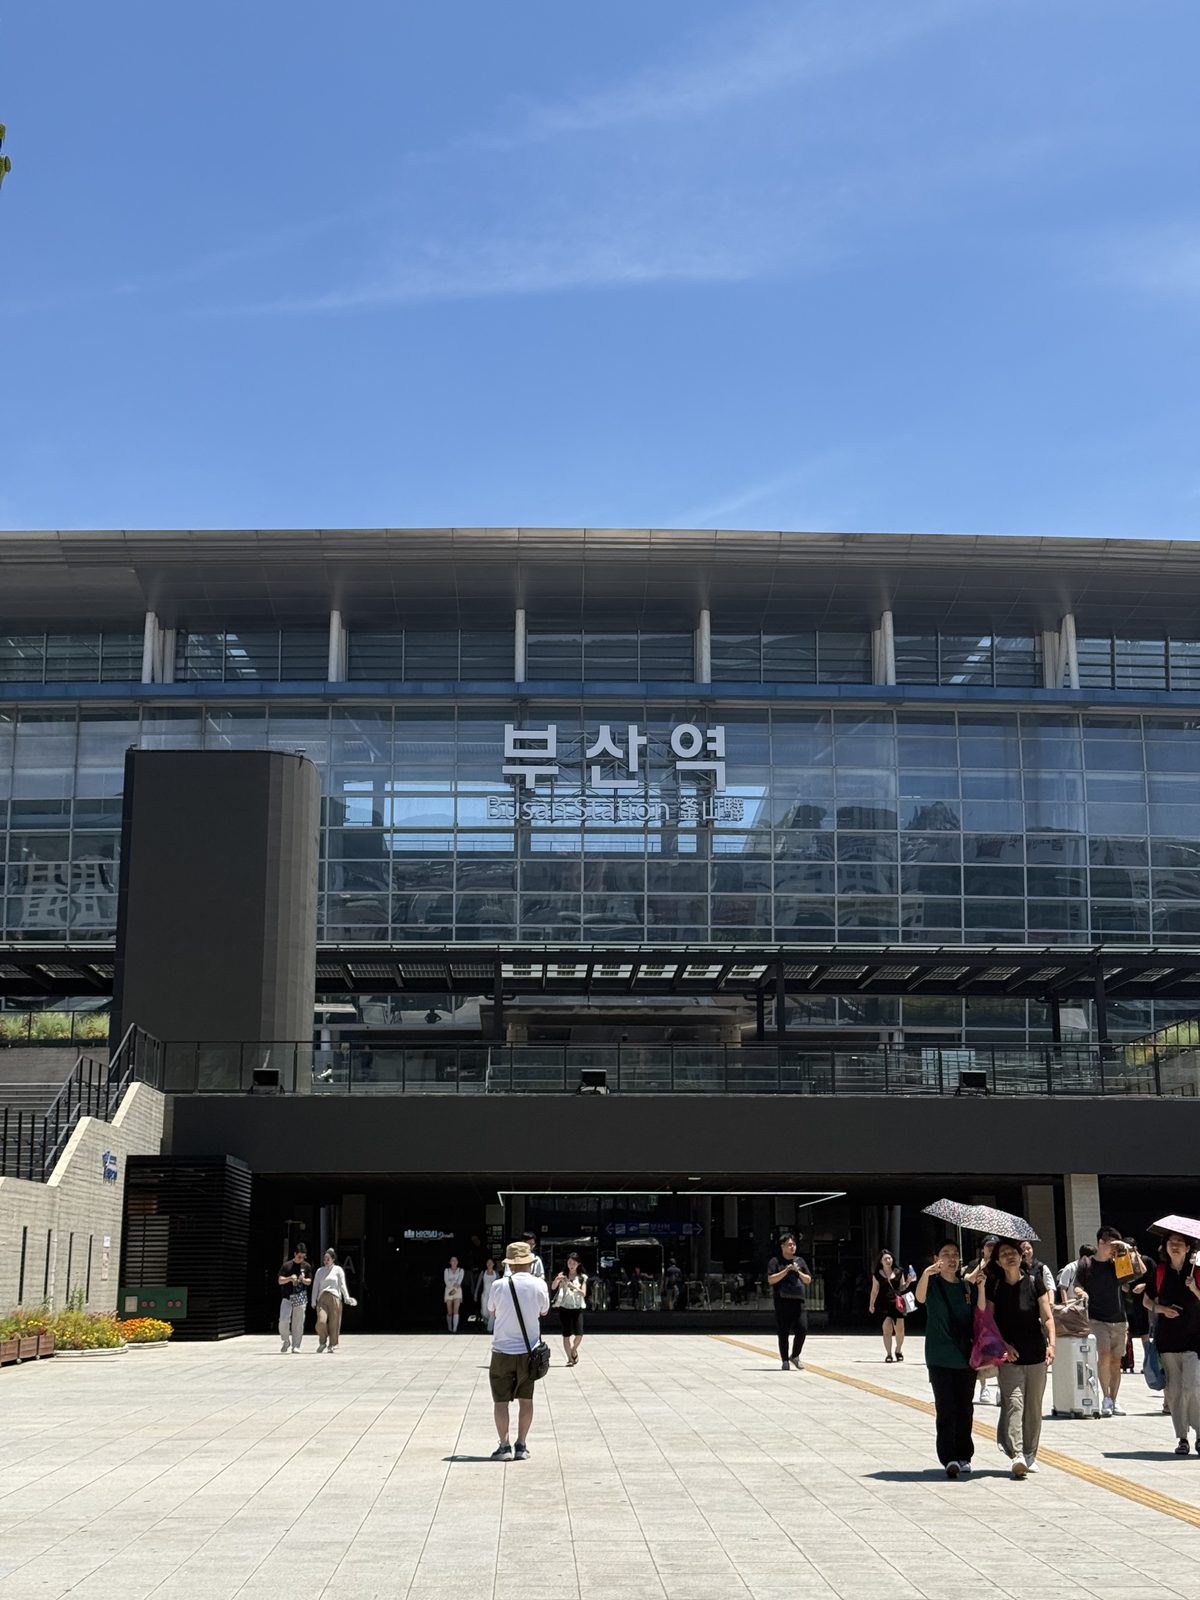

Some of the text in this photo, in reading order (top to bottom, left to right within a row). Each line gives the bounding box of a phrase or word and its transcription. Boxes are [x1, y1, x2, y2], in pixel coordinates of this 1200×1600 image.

[502, 723, 726, 792] 부산역
[486, 796, 567, 821] Busan
[575, 796, 670, 821] Station
